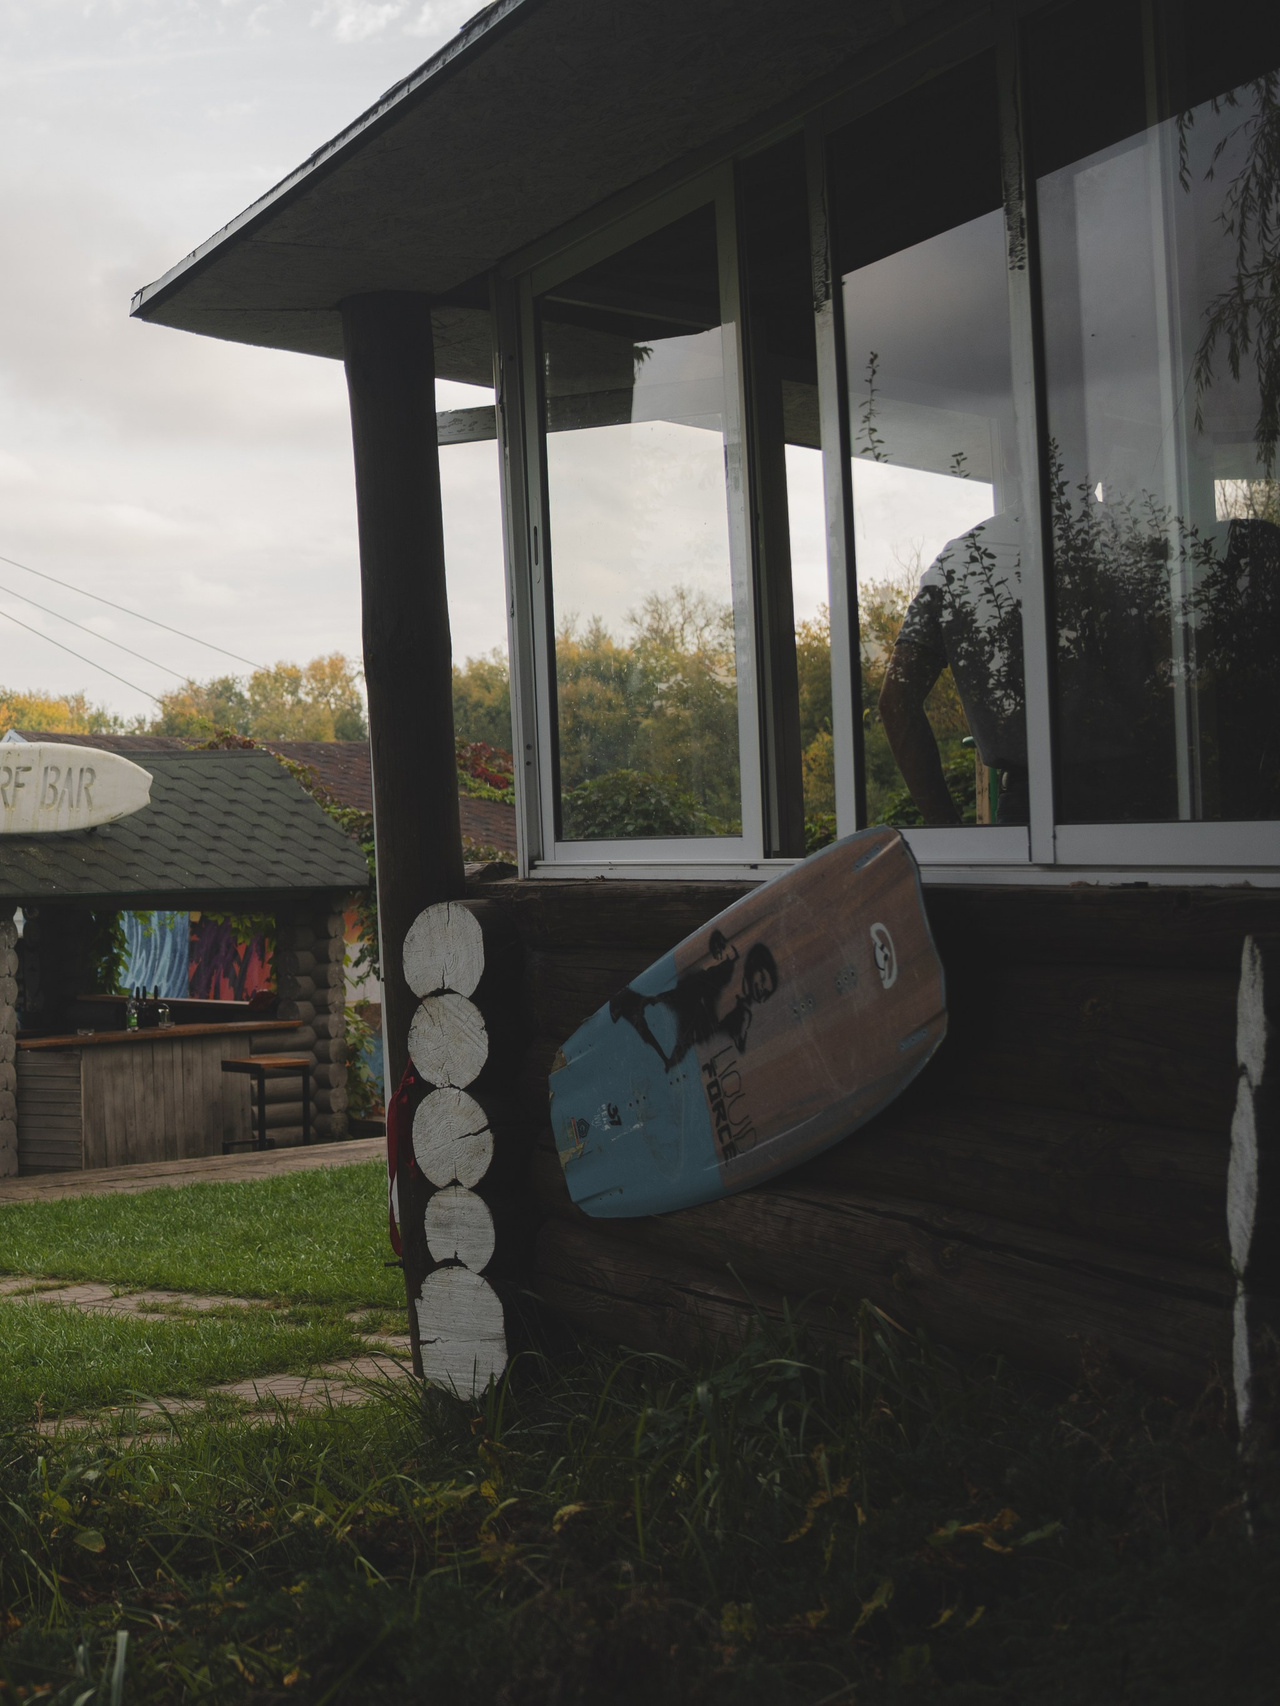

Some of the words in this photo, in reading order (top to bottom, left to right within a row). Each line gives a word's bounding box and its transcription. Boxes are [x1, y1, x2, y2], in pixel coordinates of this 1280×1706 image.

[38, 765, 97, 812] BAR
[702, 1058, 737, 1168] FORCE
[713, 1045, 757, 1154] LIQUID
